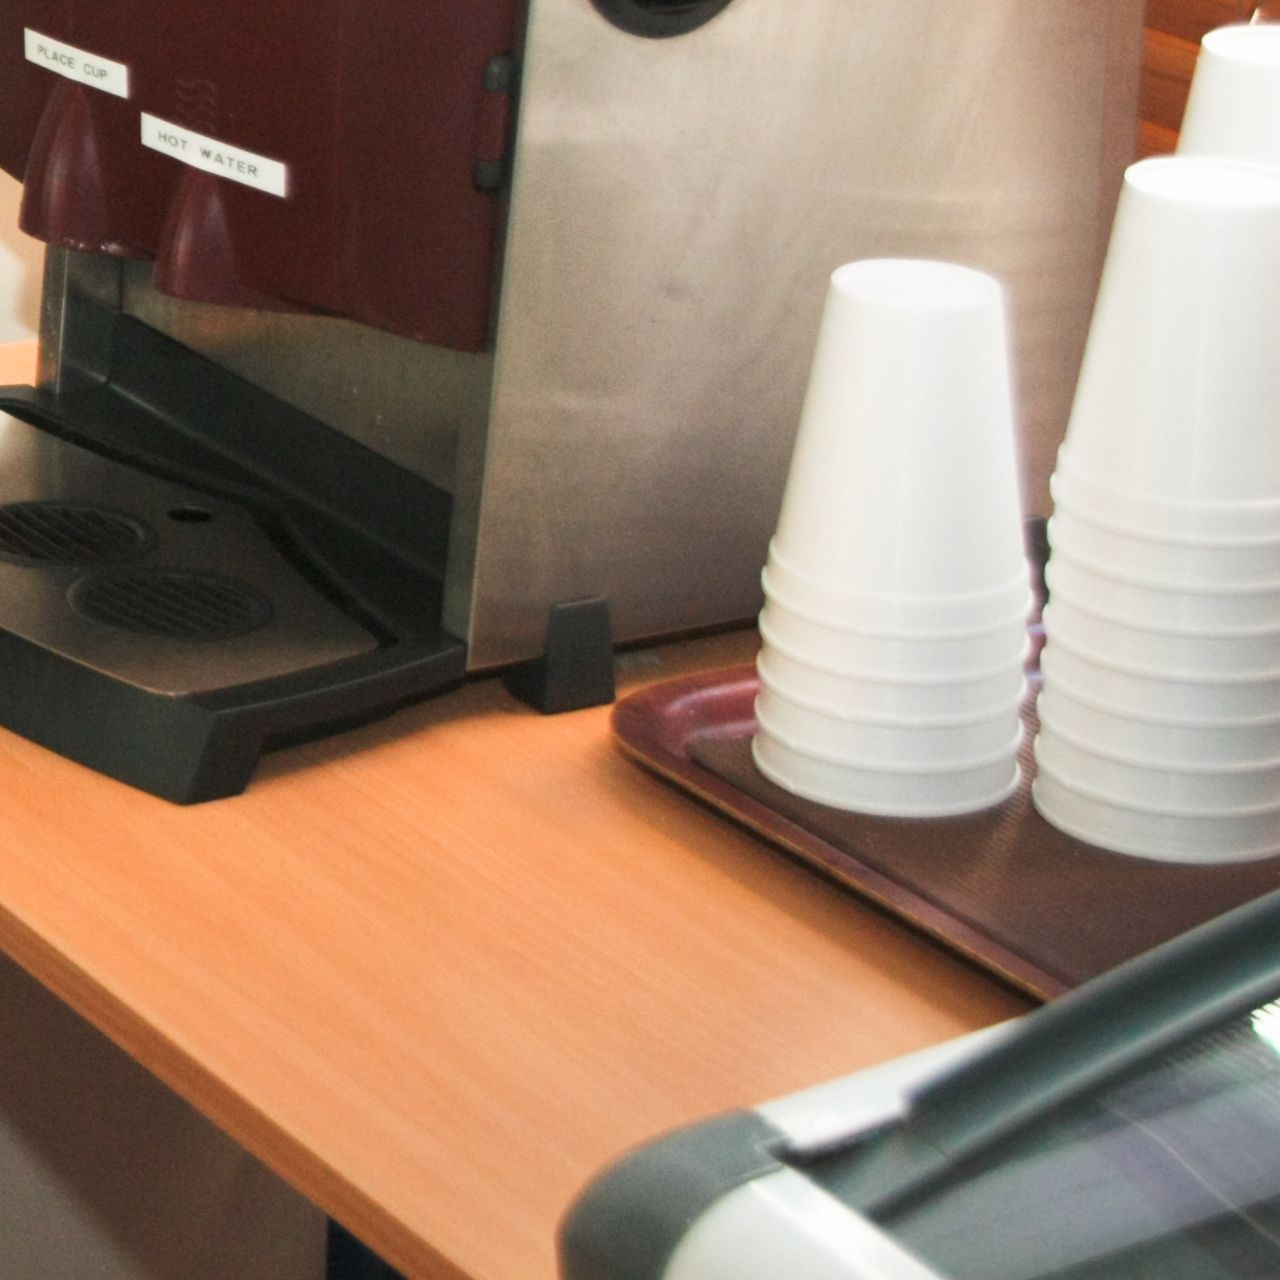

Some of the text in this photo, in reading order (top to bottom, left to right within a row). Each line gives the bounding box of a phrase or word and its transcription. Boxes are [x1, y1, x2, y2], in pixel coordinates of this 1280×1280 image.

[36, 43, 109, 81] PLACE CUP
[157, 130, 259, 178] HOT WATER
